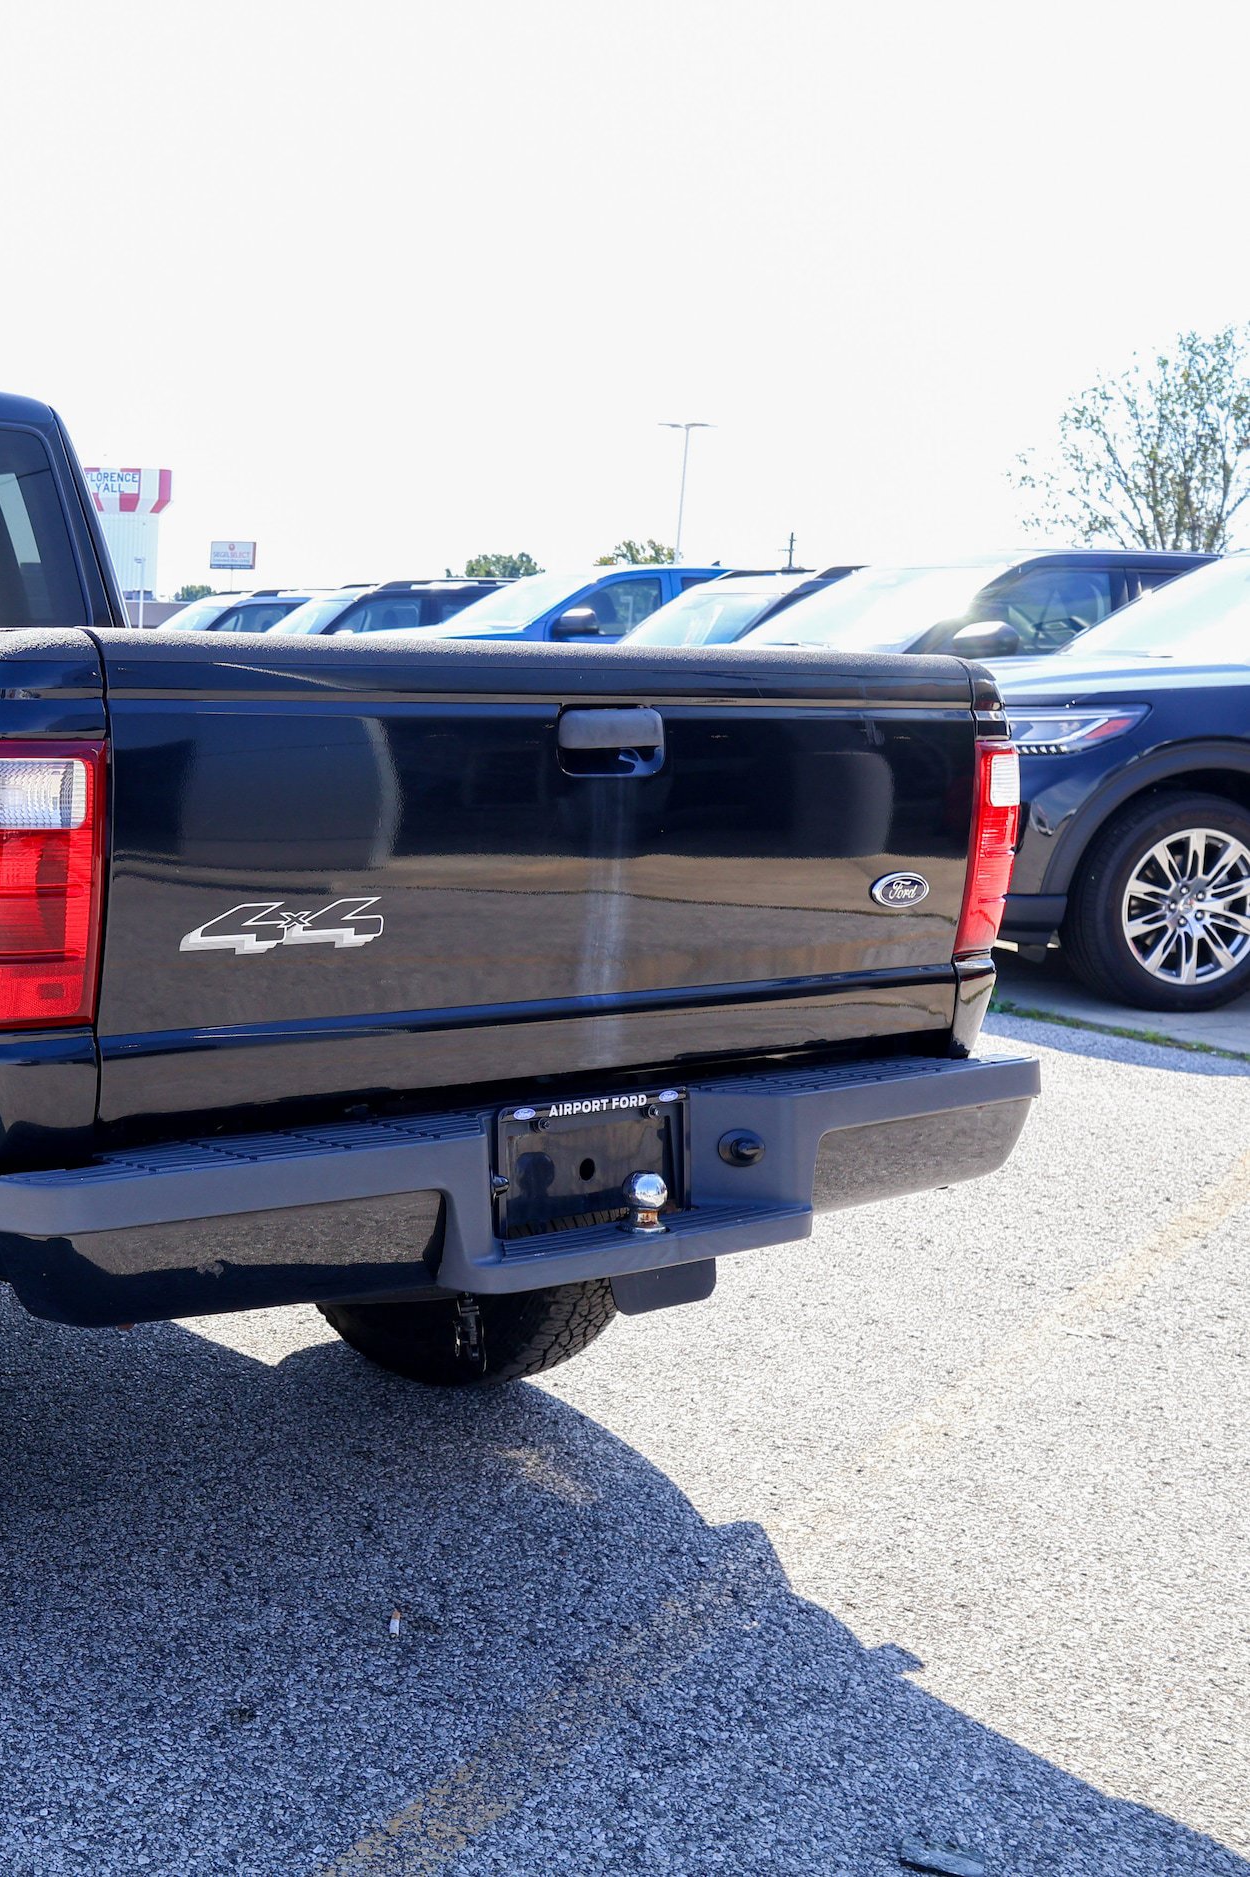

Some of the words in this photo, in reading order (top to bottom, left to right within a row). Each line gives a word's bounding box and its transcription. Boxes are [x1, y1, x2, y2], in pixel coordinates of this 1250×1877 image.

[179, 896, 384, 955] 4x4
[549, 1098, 609, 1117] AIRPORT
[612, 1094, 647, 1110] FORD
